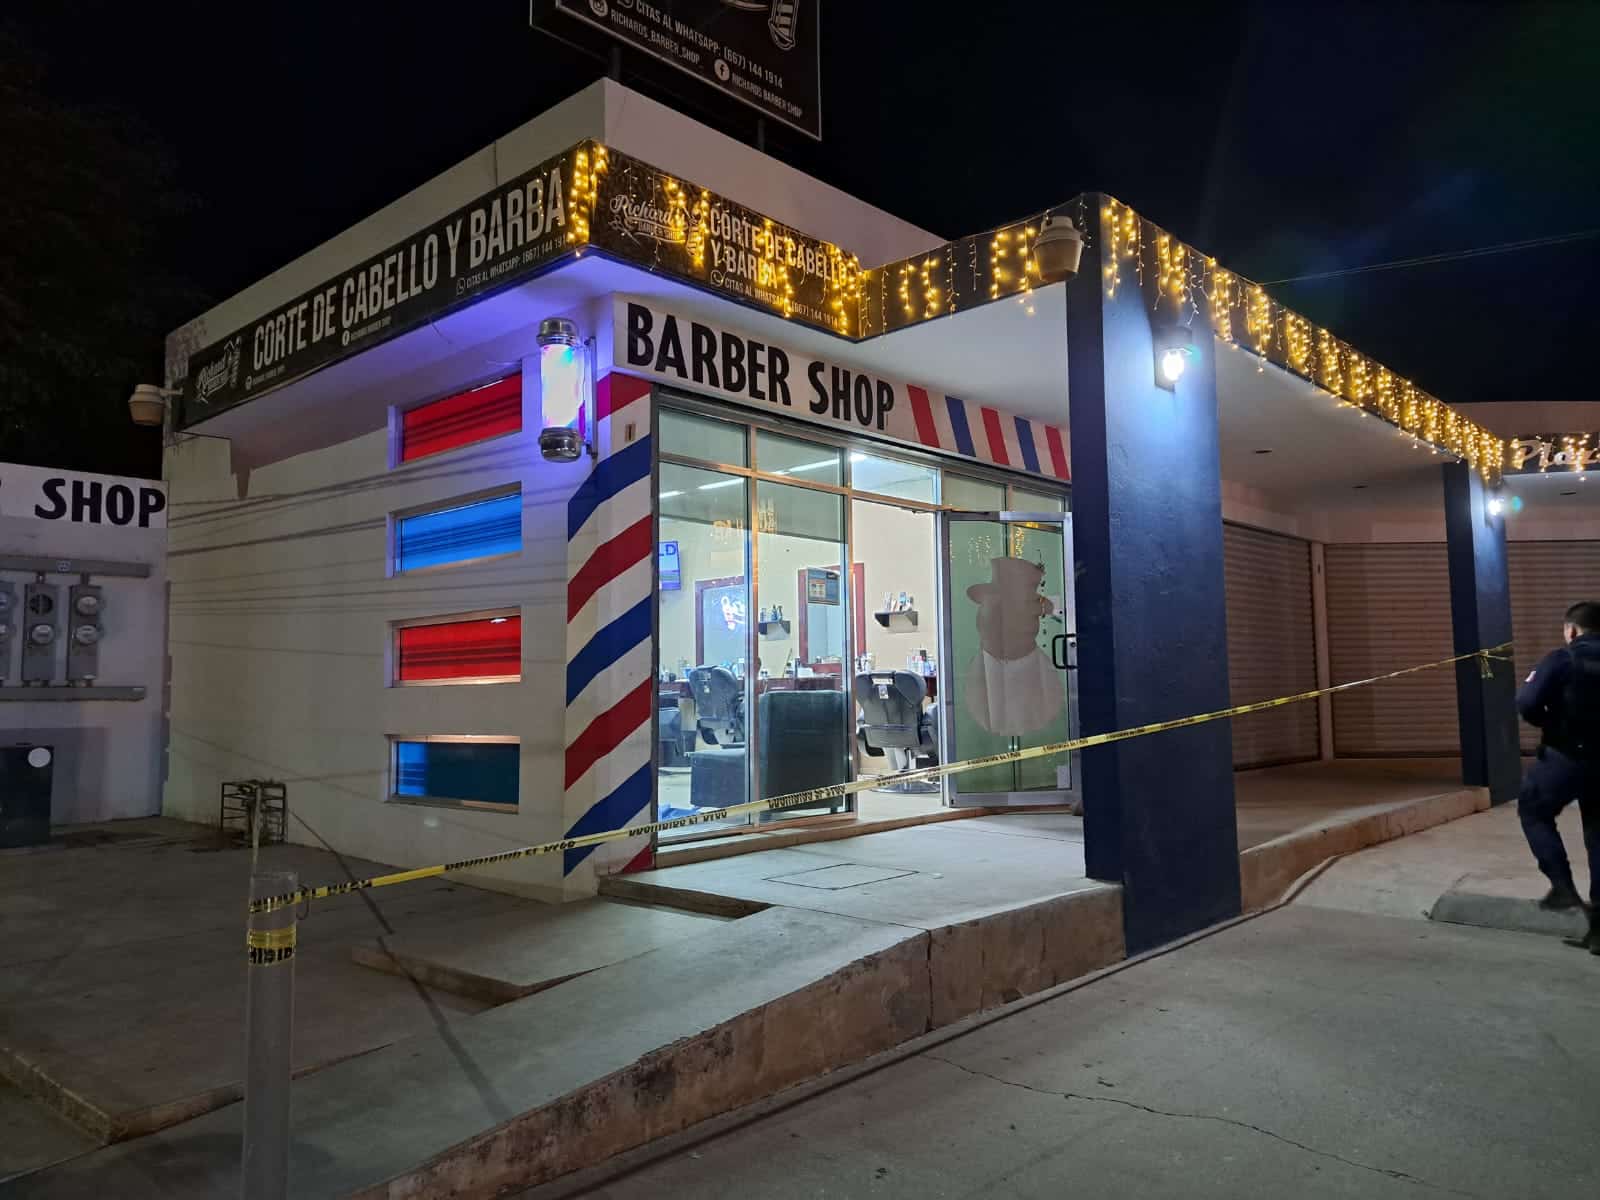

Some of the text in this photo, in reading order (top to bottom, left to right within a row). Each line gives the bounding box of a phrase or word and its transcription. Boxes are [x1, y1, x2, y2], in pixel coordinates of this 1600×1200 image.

[636, 0, 661, 24] CITAS
[662, 14, 673, 31] AL
[748, 60, 763, 79] 144
[253, 167, 566, 371] CORTE DE CABELLO Y BARBA
[711, 207, 847, 286] CORTE DE CABELLO
[711, 239, 778, 289] Y BARBA
[724, 277, 744, 294] CITAS
[745, 284, 752, 297] AL
[628, 302, 894, 430] BARBER SHOP
[35, 478, 166, 528] SHOP
